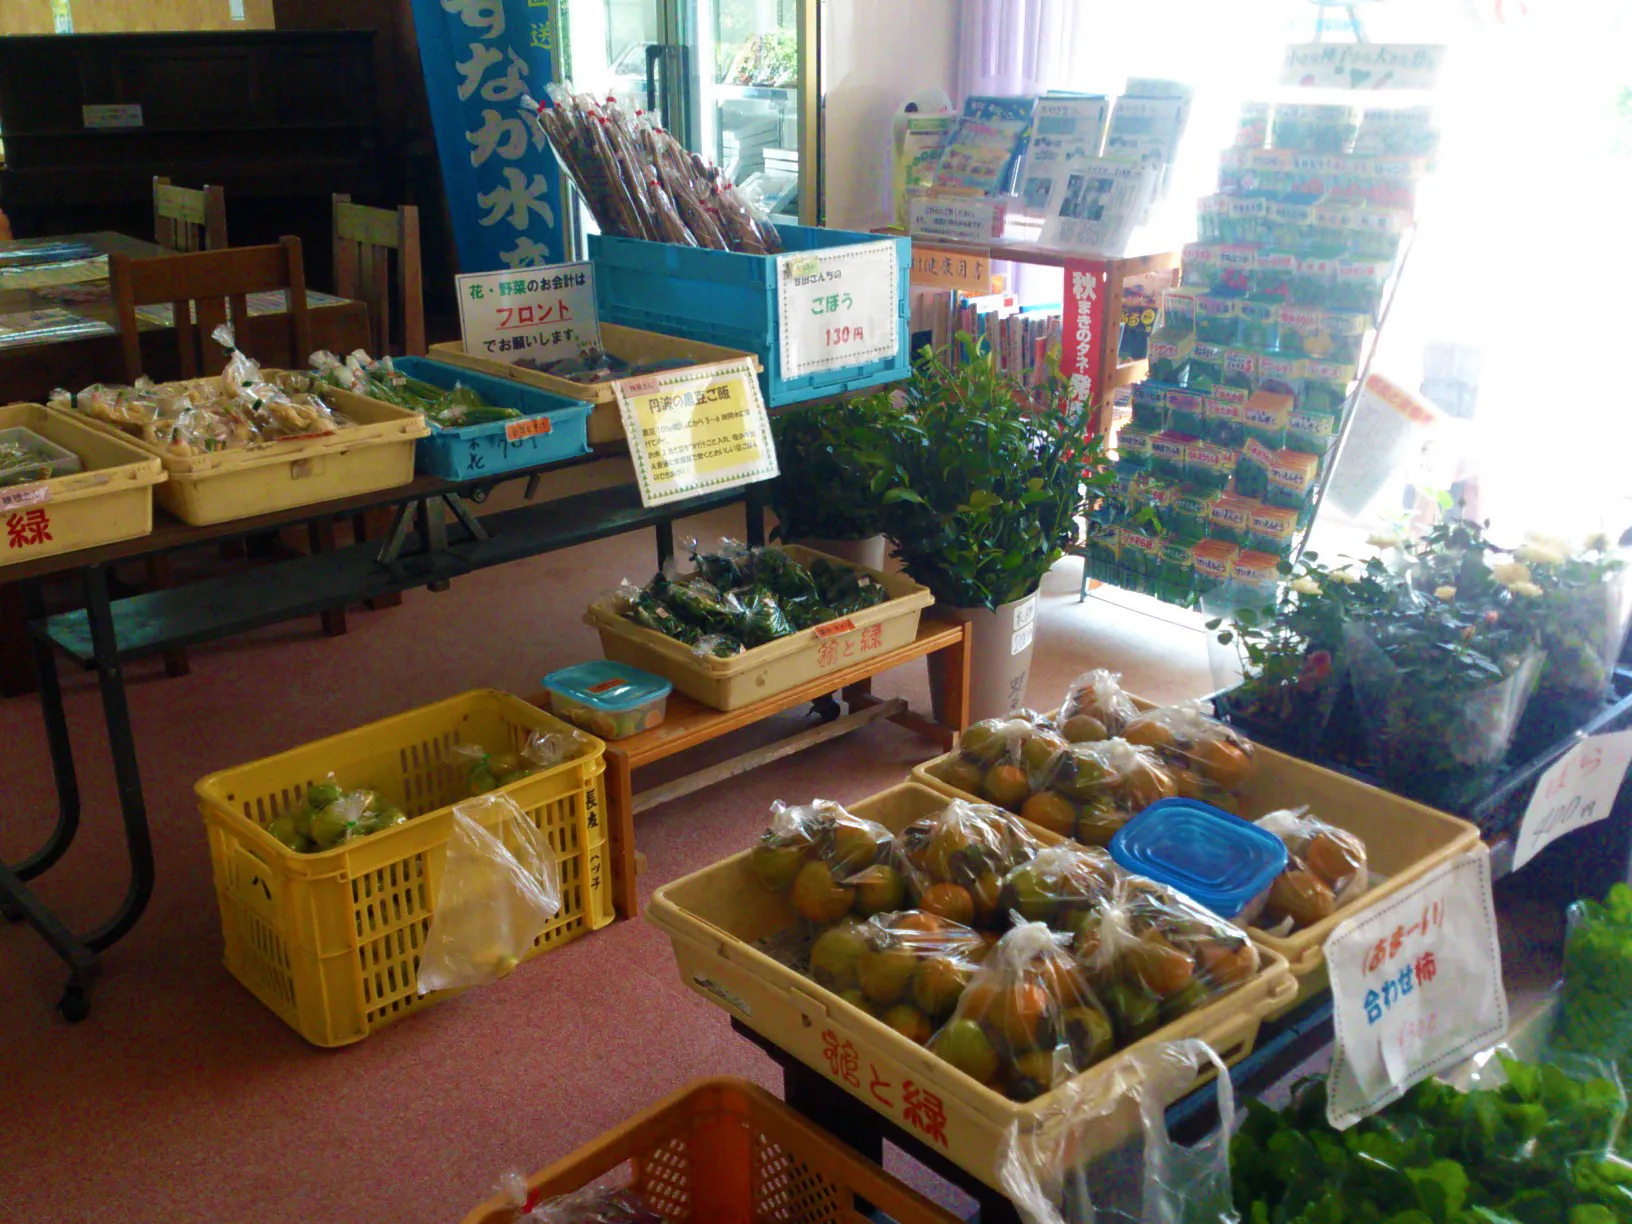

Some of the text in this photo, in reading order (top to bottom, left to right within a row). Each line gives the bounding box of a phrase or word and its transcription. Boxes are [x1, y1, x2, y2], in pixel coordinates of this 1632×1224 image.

[468, 272, 586, 300] 花・野菜のお会計は
[496, 299, 569, 327] フロント
[483, 328, 579, 353] でお願いします。
[825, 325, 864, 347] 130円
[648, 384, 731, 414] 丹波の黒豆ご飯
[6, 508, 54, 549] 緑
[1363, 951, 1437, 1026] 合わせ柿
